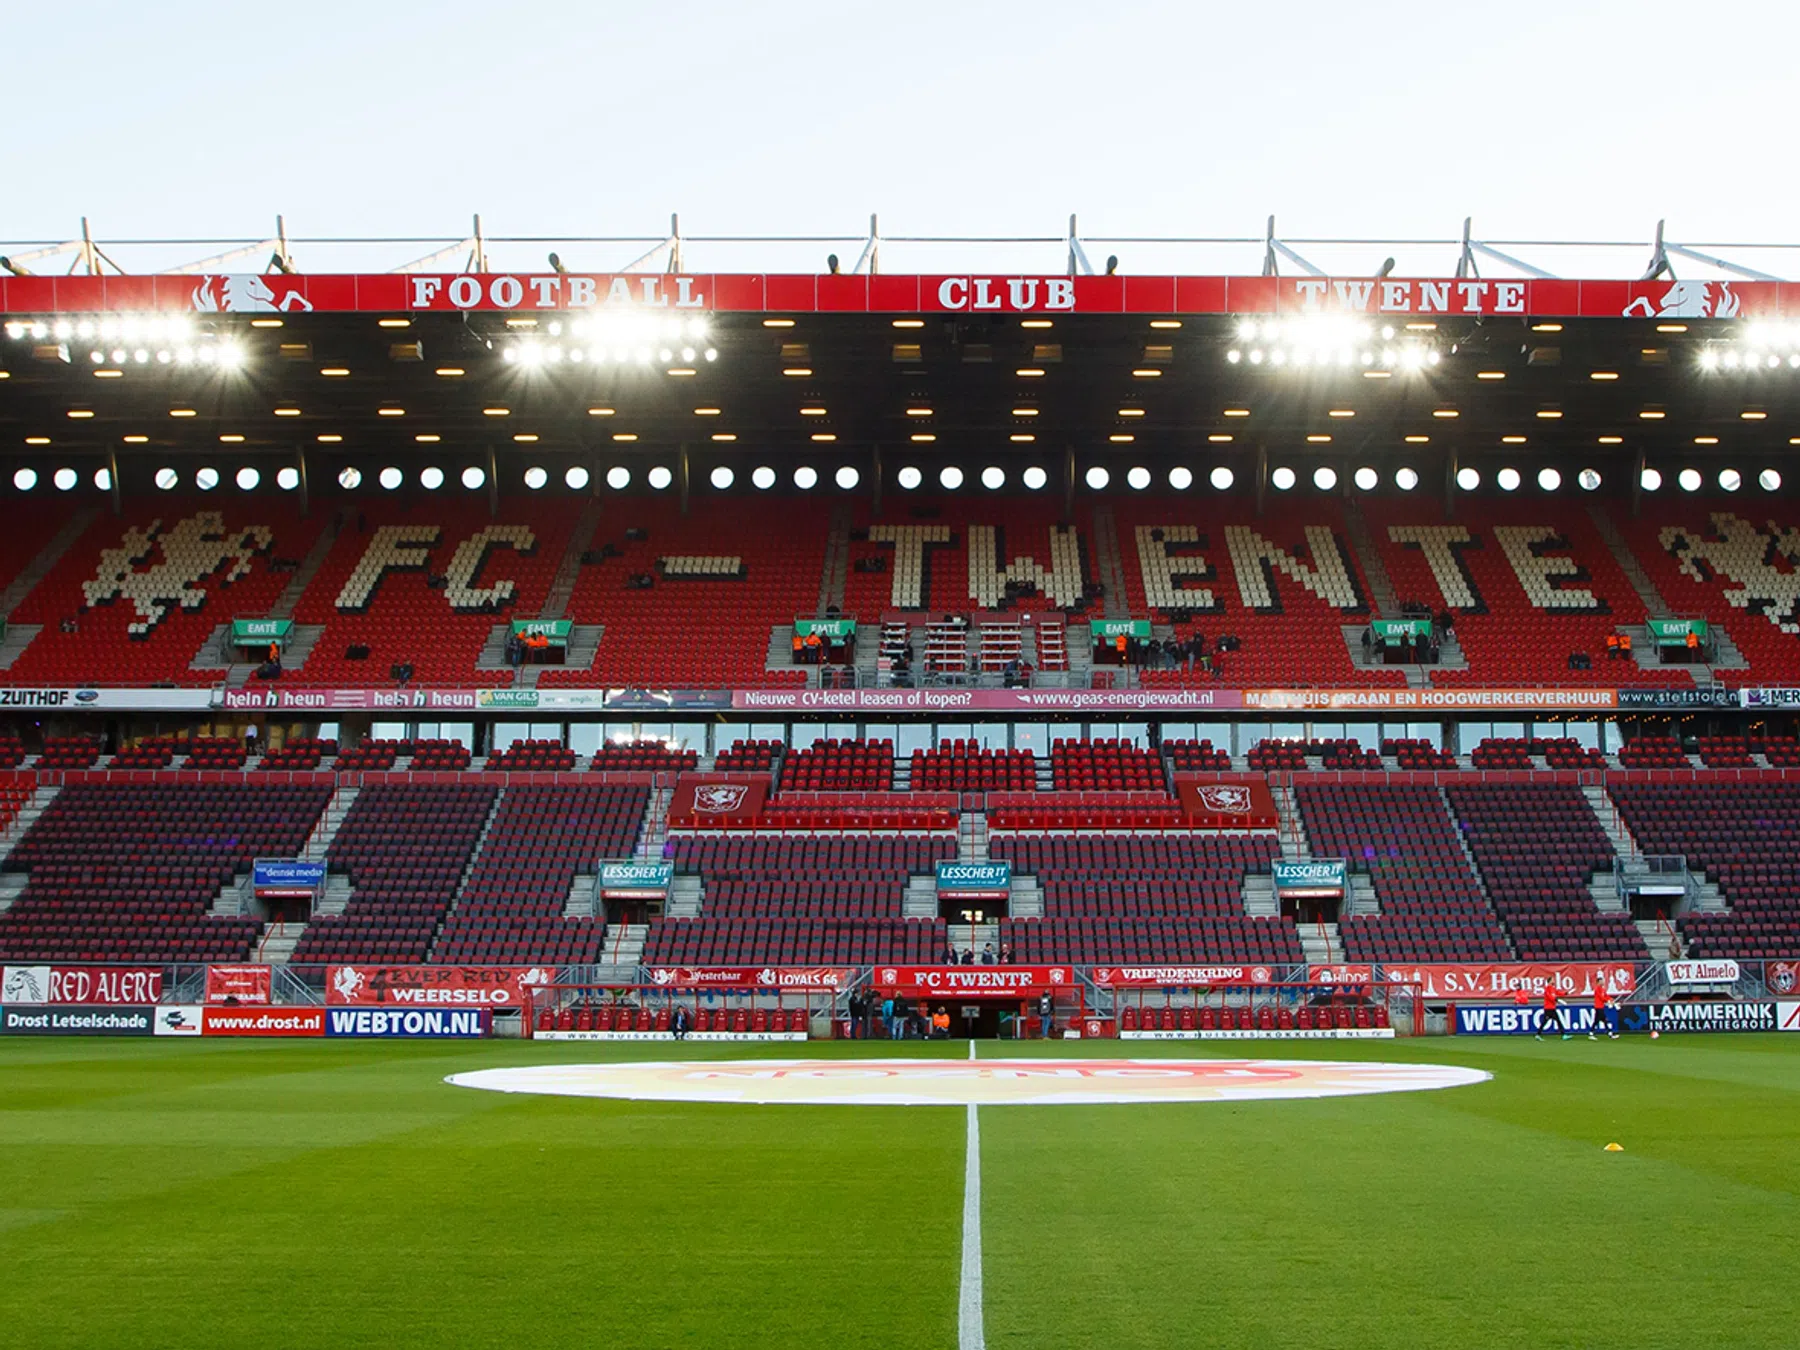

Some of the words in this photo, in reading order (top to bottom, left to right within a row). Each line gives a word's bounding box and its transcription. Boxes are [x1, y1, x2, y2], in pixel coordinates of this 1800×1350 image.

[412, 277, 703, 308] FOOTBALL
[938, 277, 1076, 309] CLUB
[1296, 280, 1524, 312] TWENTE
[336, 524, 538, 610] FC
[870, 524, 1600, 609] TWENTE
[247, 621, 277, 633] EMTÉ
[1106, 621, 1135, 633] EMTÉ
[1, 691, 69, 705] ZUITHOF
[284, 691, 325, 706] heun
[432, 691, 473, 706] heun
[493, 692, 514, 701] VAN
[516, 692, 538, 701] GILS
[745, 692, 796, 705] Nieuwe
[802, 692, 856, 705] CV-ketel
[861, 692, 904, 705] leasen
[907, 692, 921, 705] of
[925, 692, 973, 708] kopen?
[1033, 691, 1214, 707] www.geas-energiewacht.nl
[1395, 692, 1416, 705] EN
[1421, 692, 1611, 705] HOOGWERKERVERHUUR
[604, 867, 657, 879] LESSCHER
[658, 866, 669, 875] IT
[941, 867, 995, 878] LESSCHER
[995, 867, 1006, 876] IT
[1278, 866, 1330, 878] LESSCHER
[1121, 967, 1243, 979] VRIENDENKRING
[1695, 963, 1736, 978] Almelo
[779, 974, 821, 985] LOYALS
[823, 974, 838, 985] 66
[914, 972, 941, 987] FC
[945, 972, 1033, 987] TWENTE
[1444, 973, 1485, 991] S.V.
[1491, 972, 1574, 993] Henglo
[50, 971, 90, 1002] RED
[94, 972, 162, 1003] ALERT
[391, 989, 510, 1003] WEERSELO
[1649, 1004, 1773, 1020] LAMMERINK
[8, 1013, 48, 1028] Drost
[52, 1013, 148, 1028] Letselschade
[208, 1015, 320, 1029] www.drost.nl
[332, 1012, 484, 1033] WEBTON.NL
[1649, 1020, 1774, 1030] INSTALLATIEGROEP
